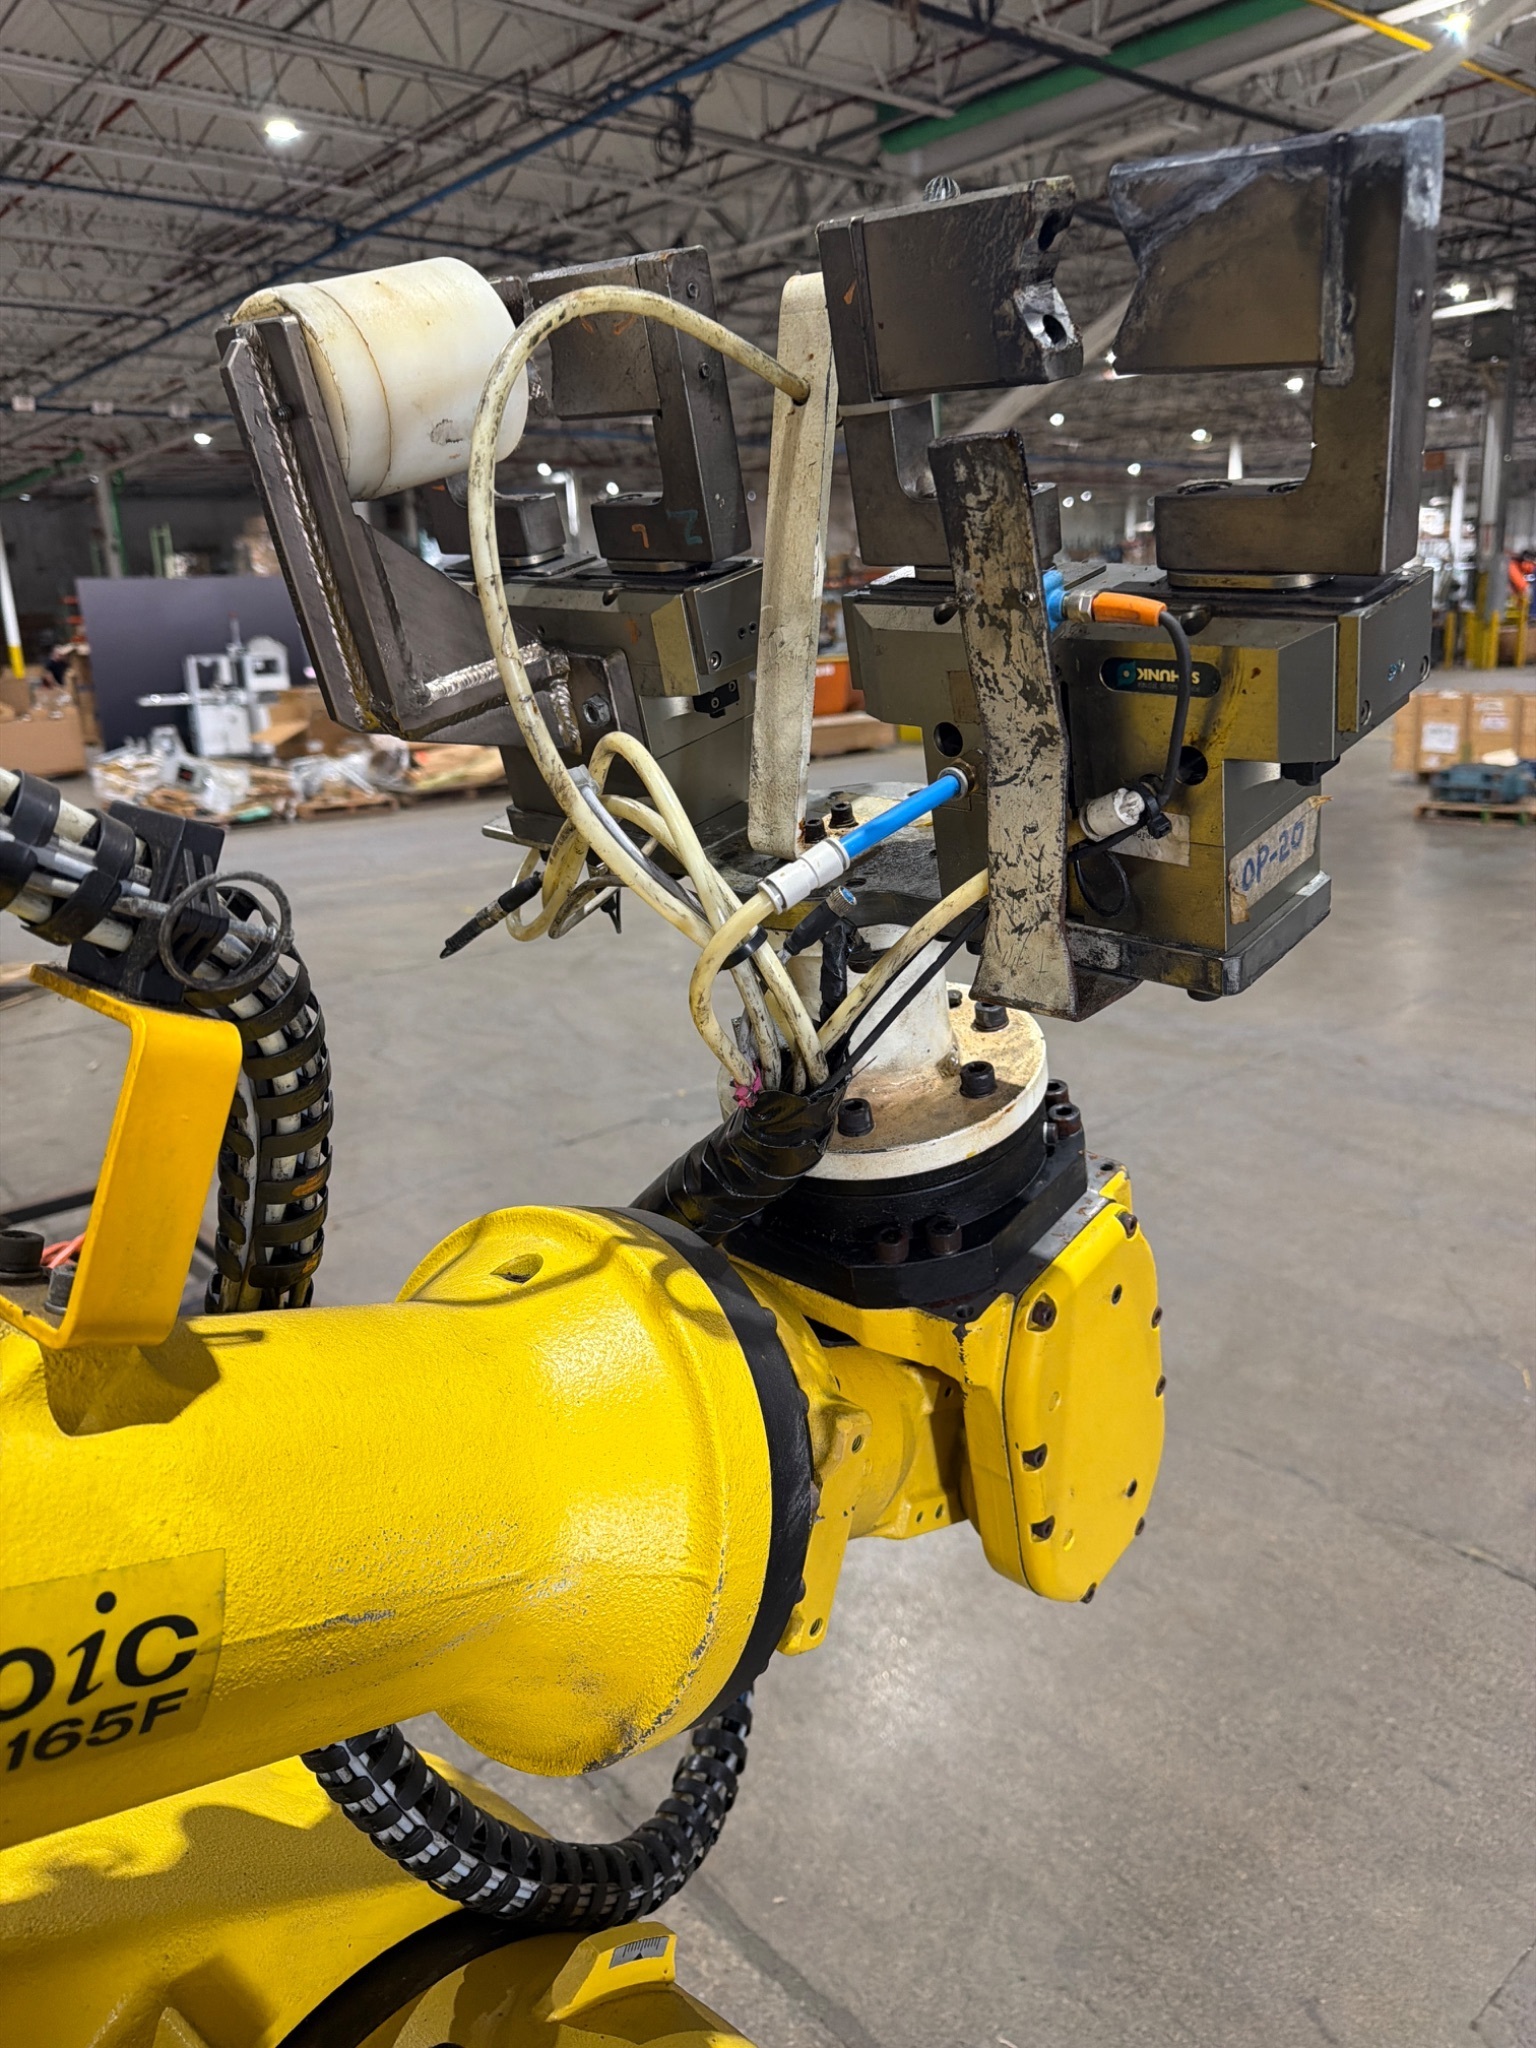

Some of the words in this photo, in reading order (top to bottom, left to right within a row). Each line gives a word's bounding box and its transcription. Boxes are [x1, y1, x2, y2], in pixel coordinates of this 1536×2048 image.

[1136, 667, 1200, 685] SHUNK
[1241, 821, 1304, 892] OP-20
[6, 1688, 189, 1772] 165F
